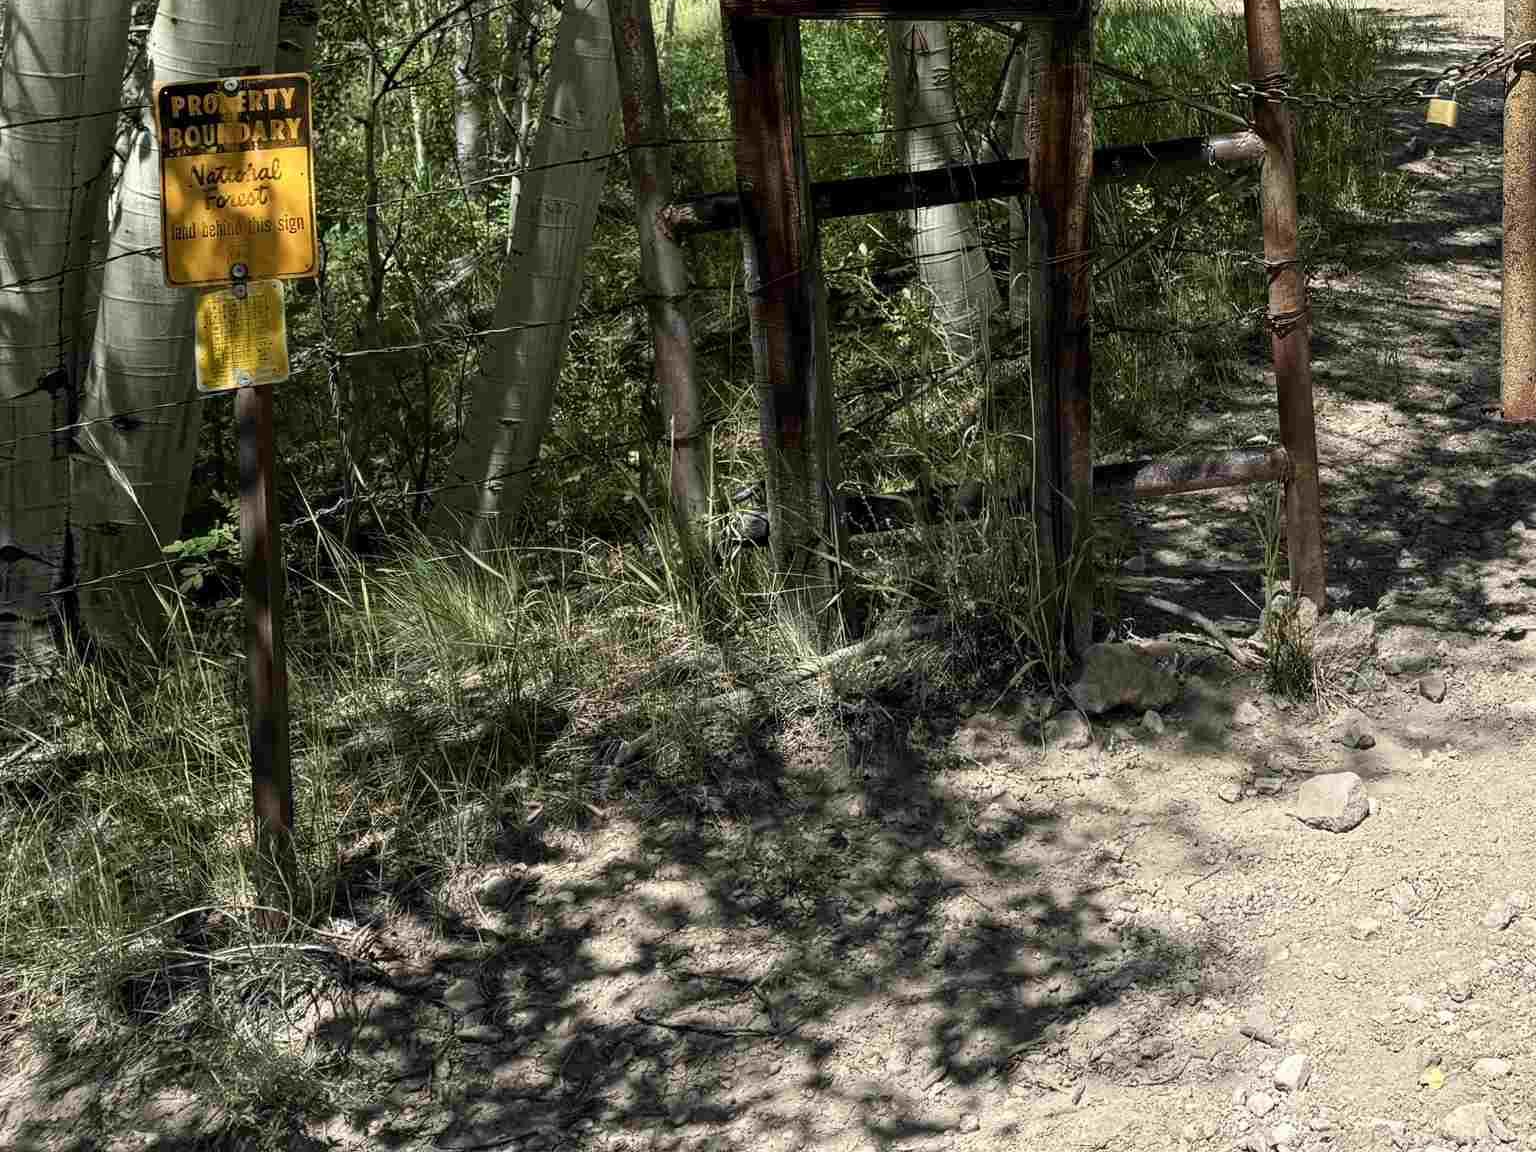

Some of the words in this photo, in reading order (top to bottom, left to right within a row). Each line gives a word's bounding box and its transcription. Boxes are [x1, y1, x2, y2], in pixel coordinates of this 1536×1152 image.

[170, 87, 297, 117] PROERTY
[168, 117, 302, 149] BOUDARY
[278, 214, 305, 234] sign
